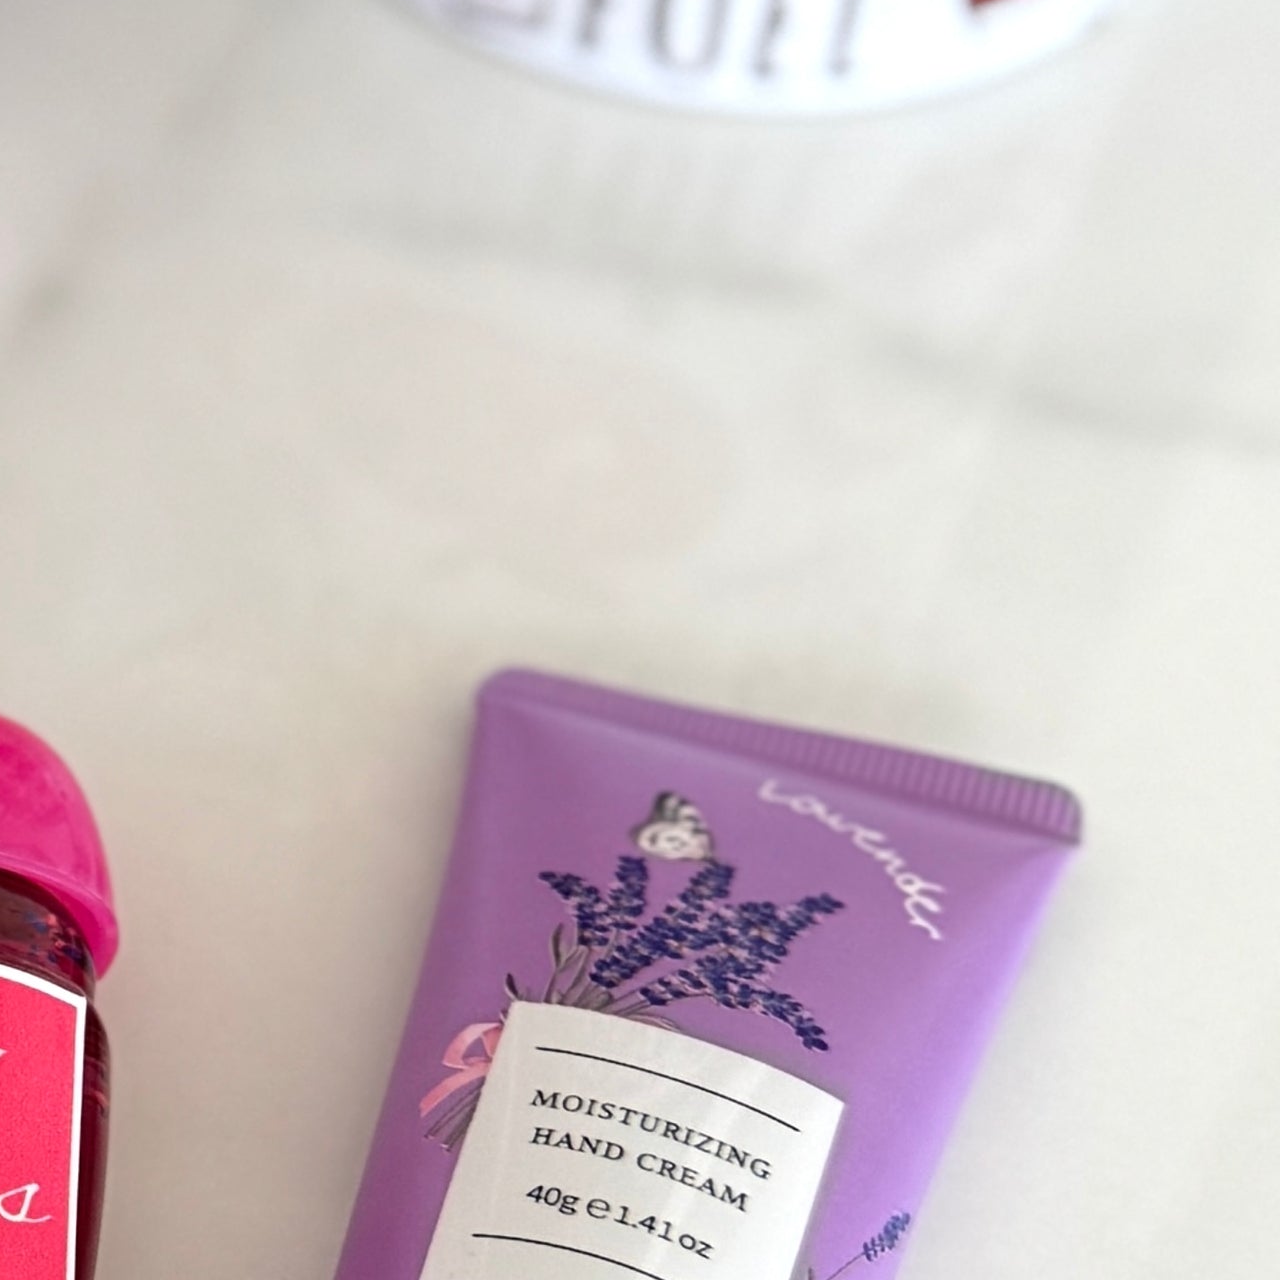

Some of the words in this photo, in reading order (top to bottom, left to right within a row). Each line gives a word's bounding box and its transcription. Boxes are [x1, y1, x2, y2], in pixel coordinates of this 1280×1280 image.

[529, 1088, 773, 1180] MOISTURIZING
[529, 1126, 625, 1162] HAND
[635, 1153, 750, 1213] CREAM
